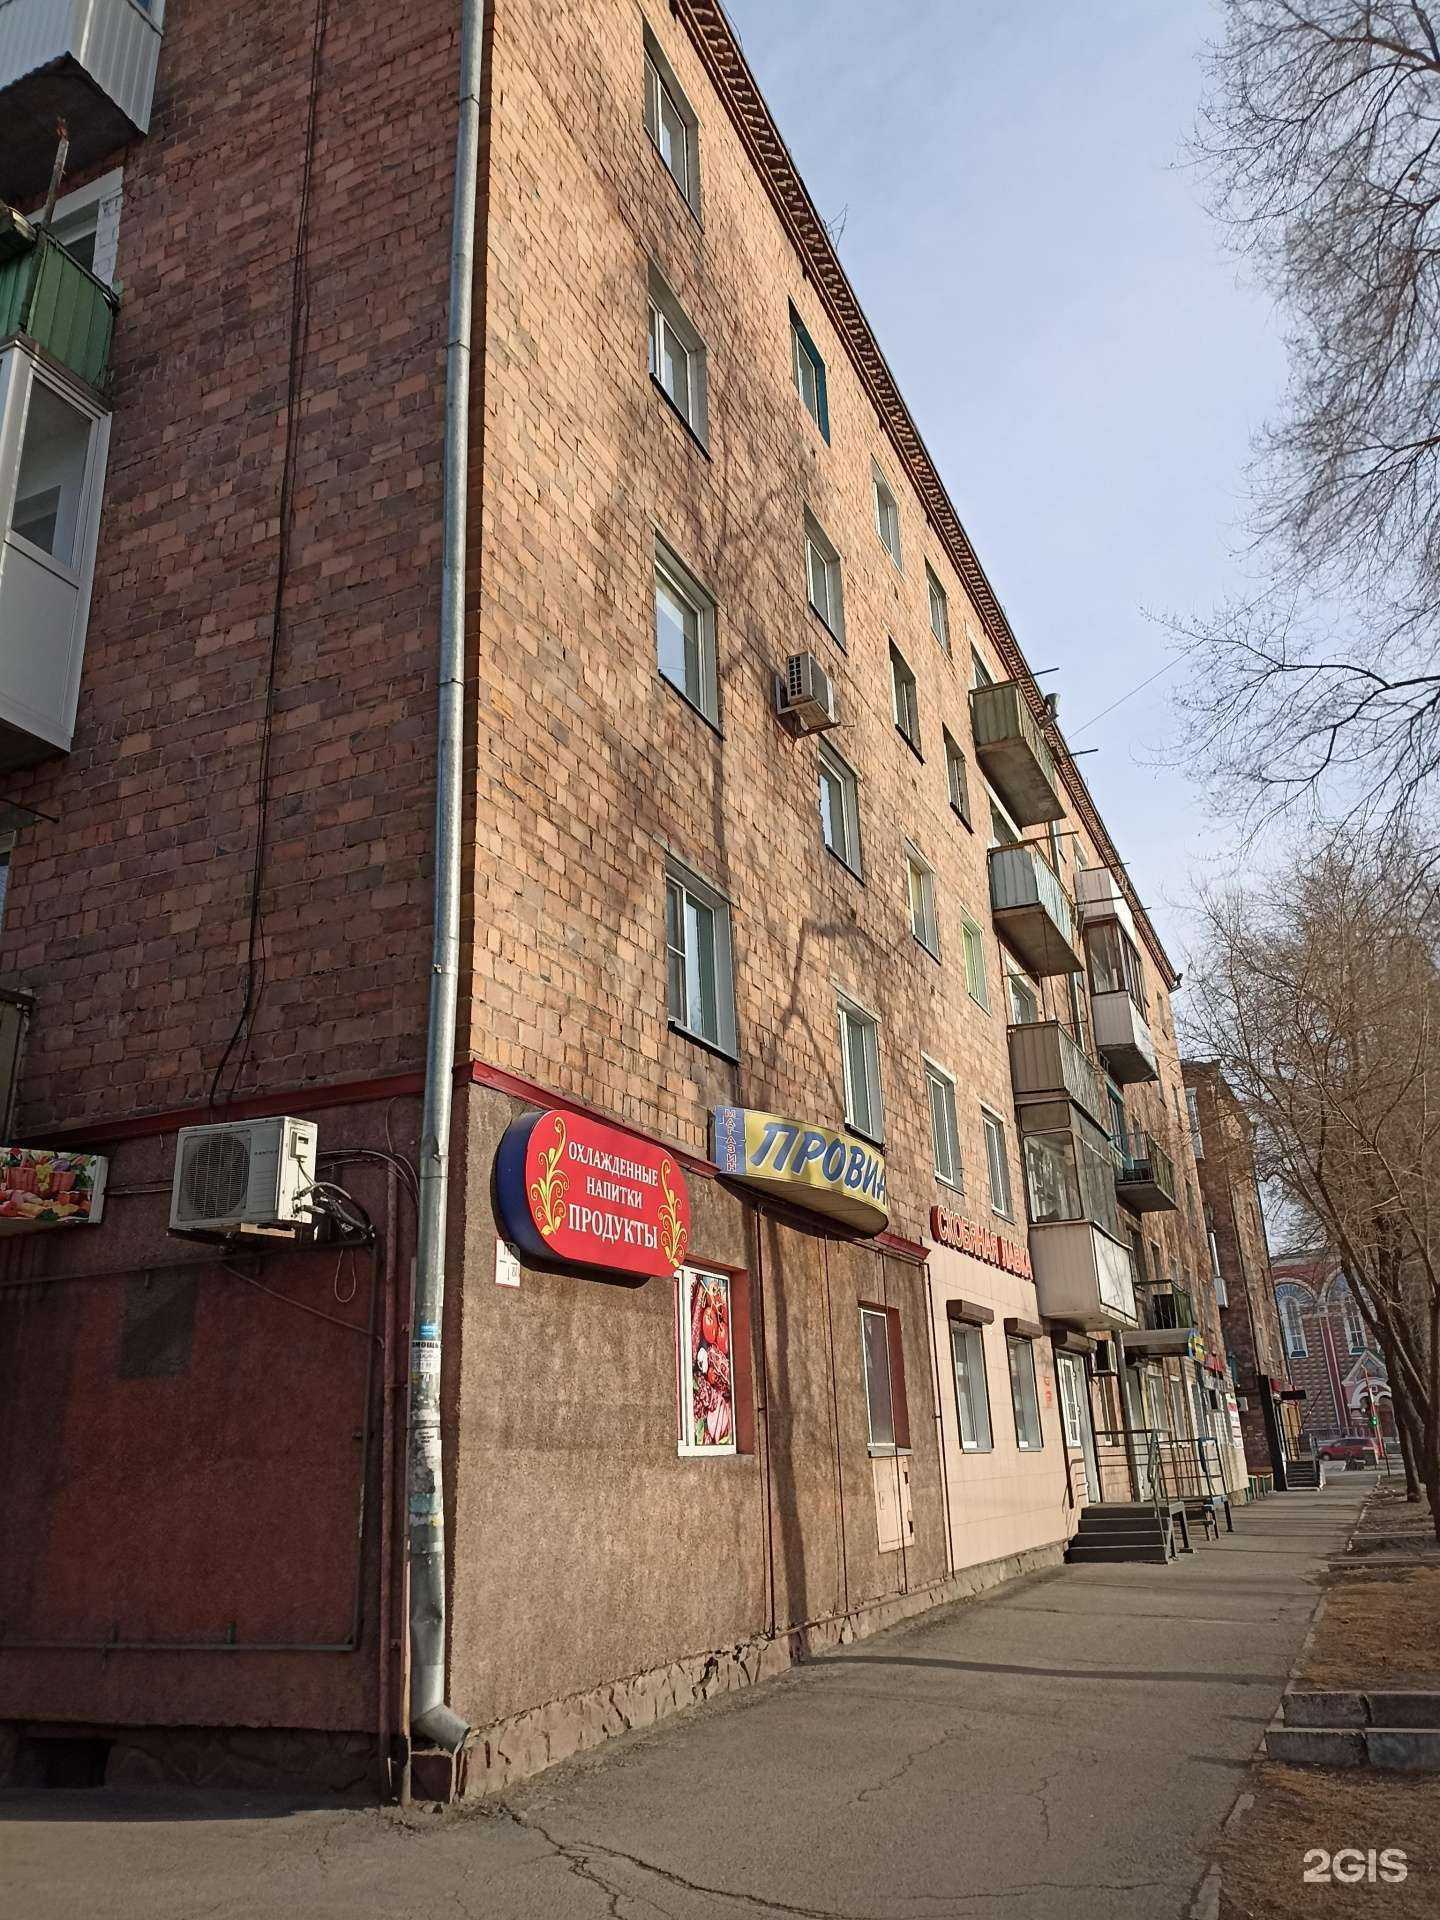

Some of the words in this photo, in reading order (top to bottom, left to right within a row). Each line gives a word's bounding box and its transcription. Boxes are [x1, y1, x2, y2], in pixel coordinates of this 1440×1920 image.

[724, 1108, 737, 1173] МАГАЗИН
[568, 1141, 659, 1187] ОХЛАЖДЕННЫЕ
[586, 1176, 642, 1209] НАПИТКИ
[568, 1203, 658, 1249] ПРОДУКТЫ
[935, 1204, 999, 1265] СКОБЯНАЯ
[1000, 1236, 1034, 1281] ЛАВКА
